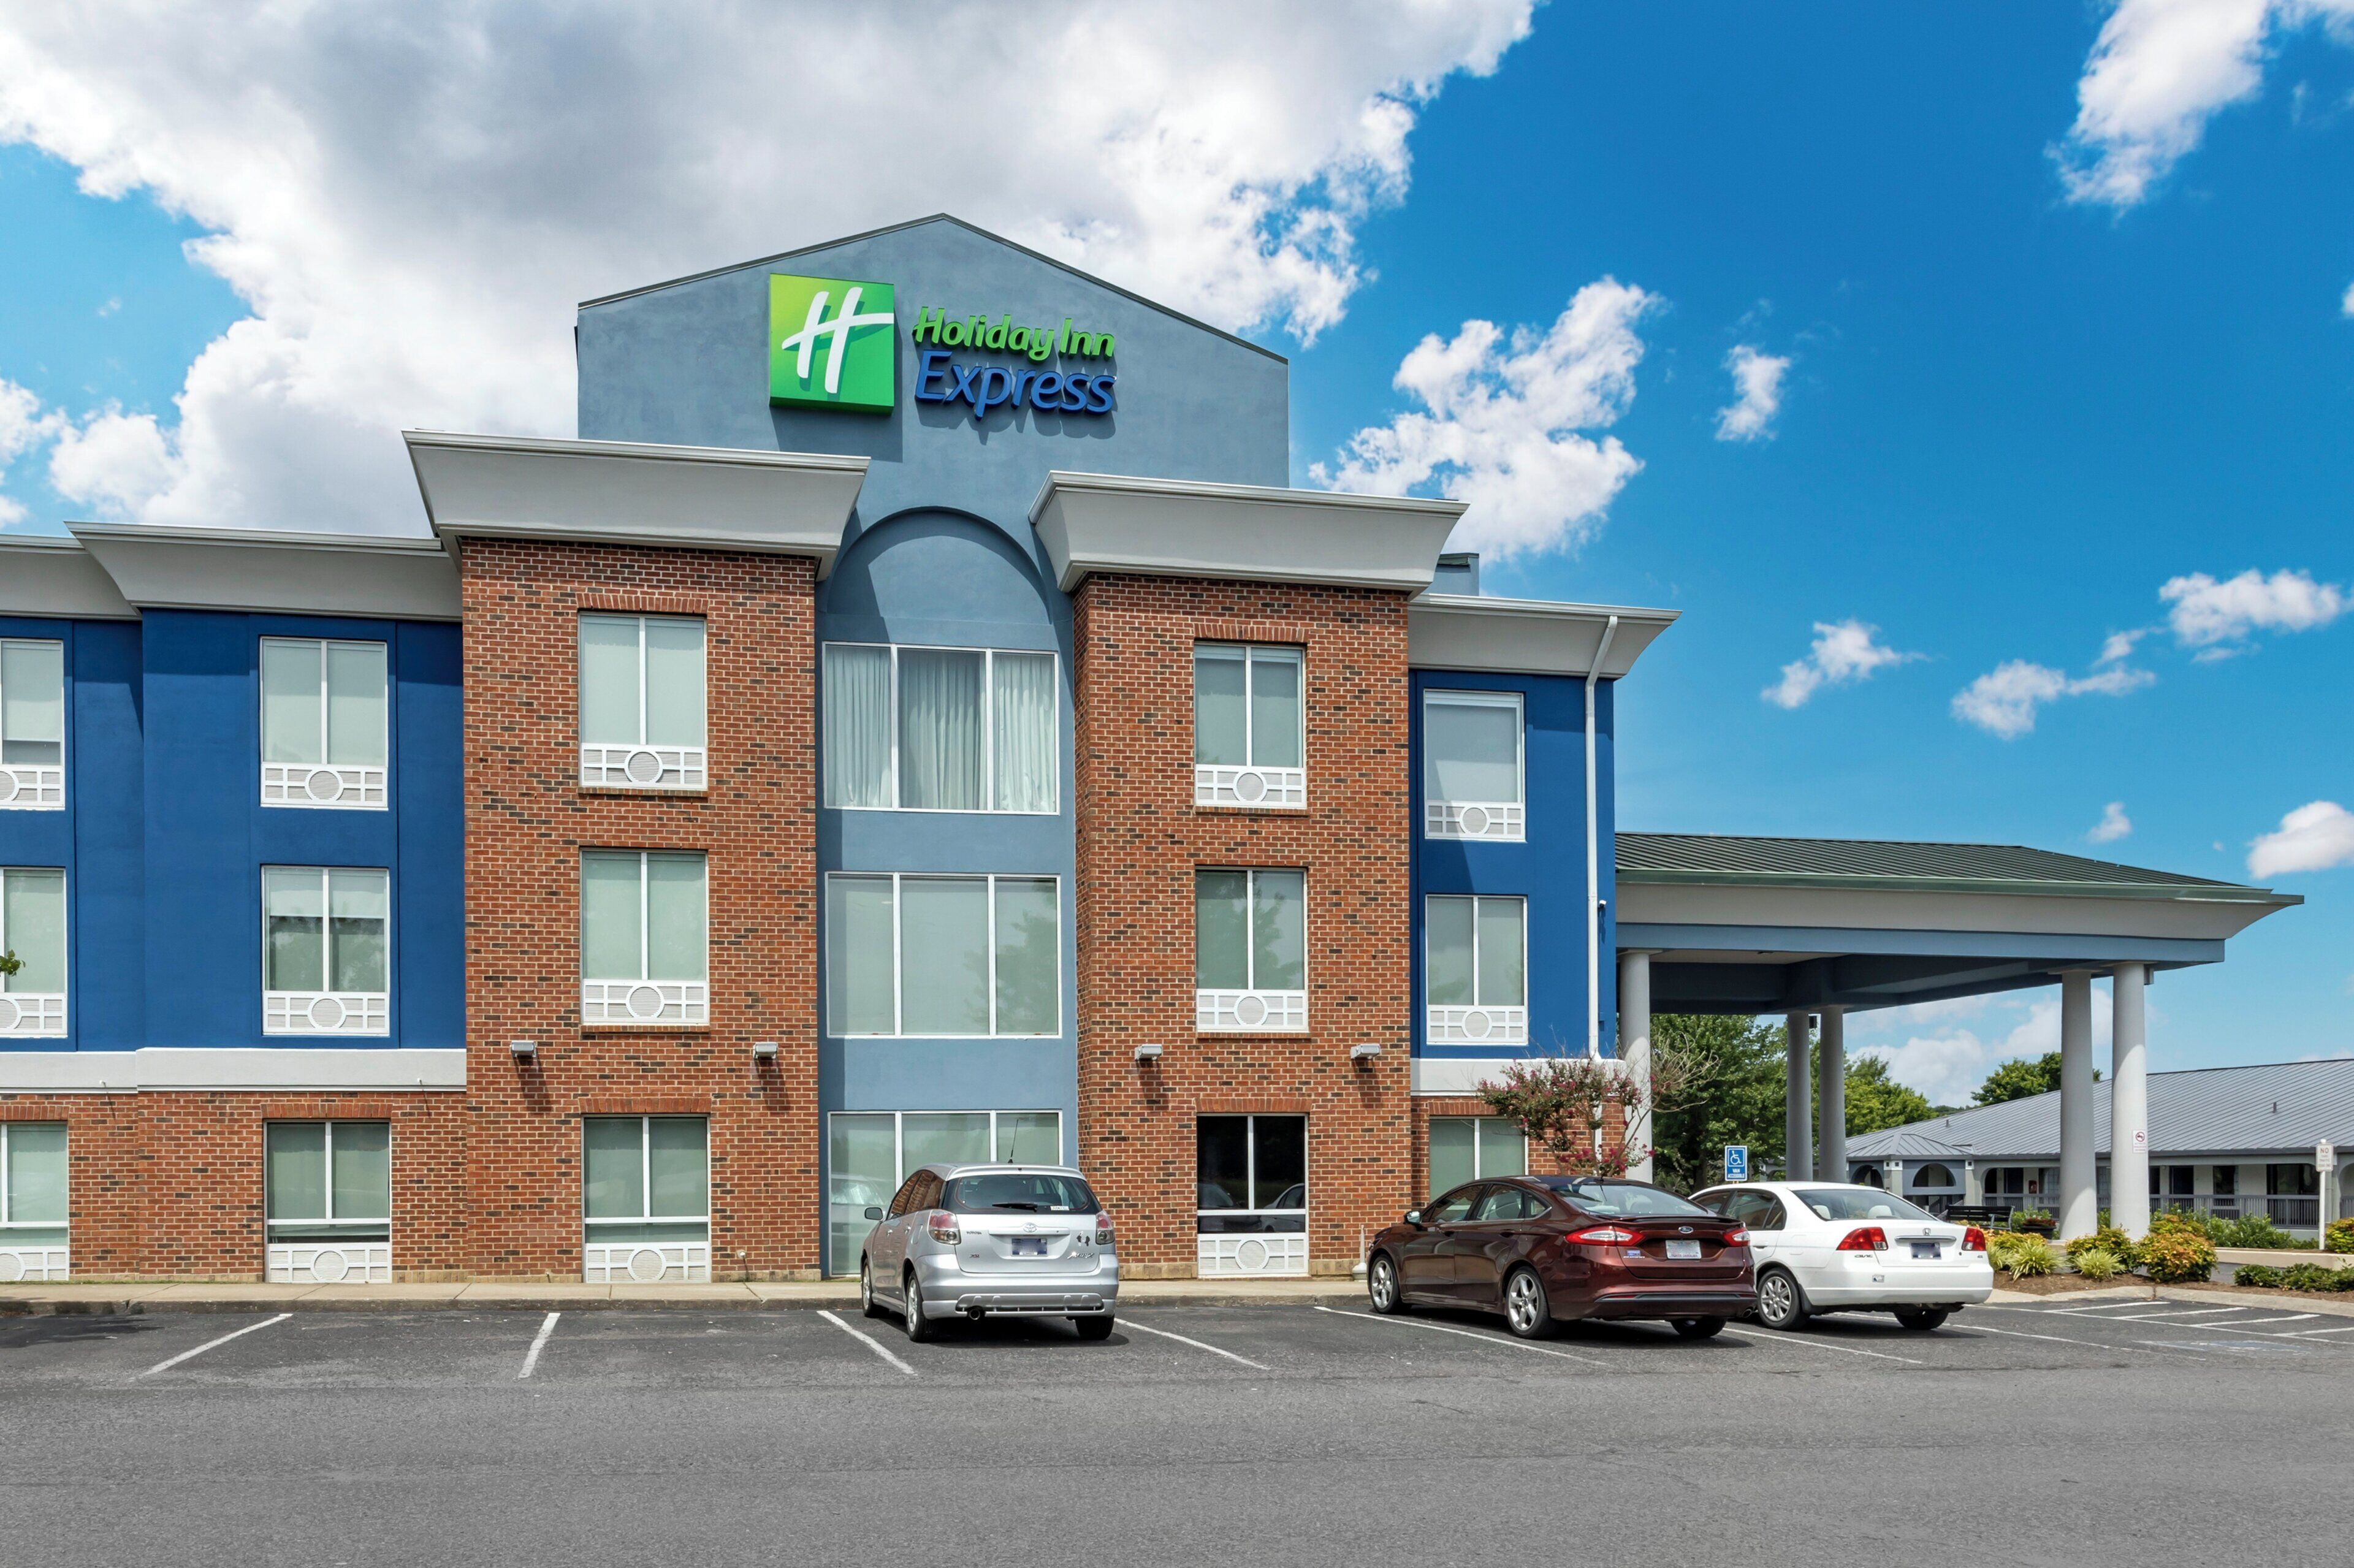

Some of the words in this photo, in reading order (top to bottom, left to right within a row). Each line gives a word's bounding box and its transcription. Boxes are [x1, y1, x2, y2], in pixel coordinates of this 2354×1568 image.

[912, 306, 1054, 364] Holiday
[1059, 318, 1115, 360] Inn
[915, 349, 1116, 421] Express
